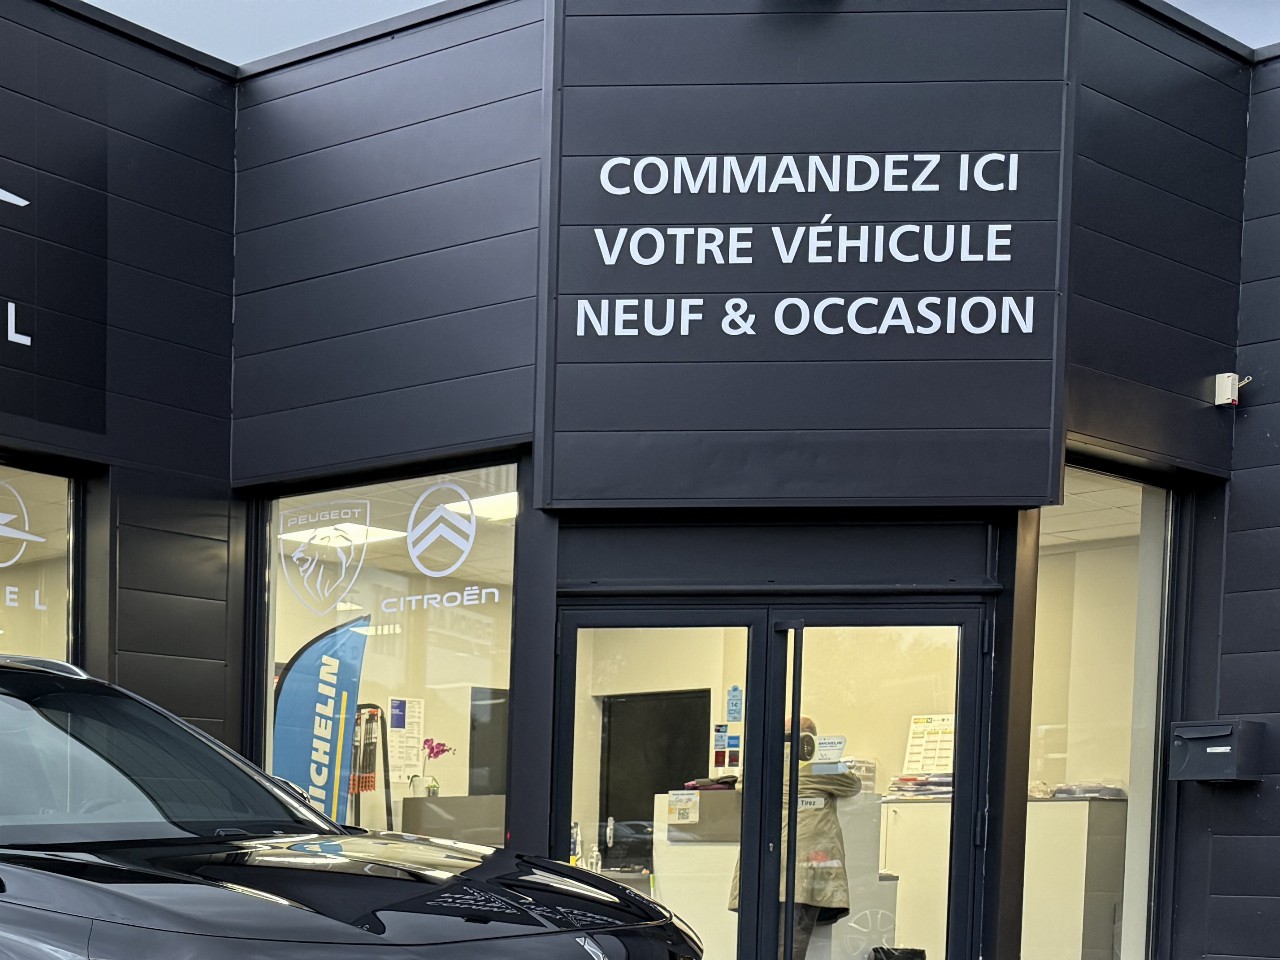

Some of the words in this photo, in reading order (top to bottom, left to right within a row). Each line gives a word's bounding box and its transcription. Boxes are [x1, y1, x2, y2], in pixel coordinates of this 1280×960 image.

[599, 153, 940, 195] COMMANDEZ
[958, 153, 1019, 192] ICI
[594, 226, 753, 266] VOTRE
[771, 213, 1013, 264] VÉHICULE
[575, 298, 704, 336] NEUF
[720, 297, 756, 335] &
[773, 296, 1035, 335] OCCASION
[287, 508, 362, 527] PEUGEOT
